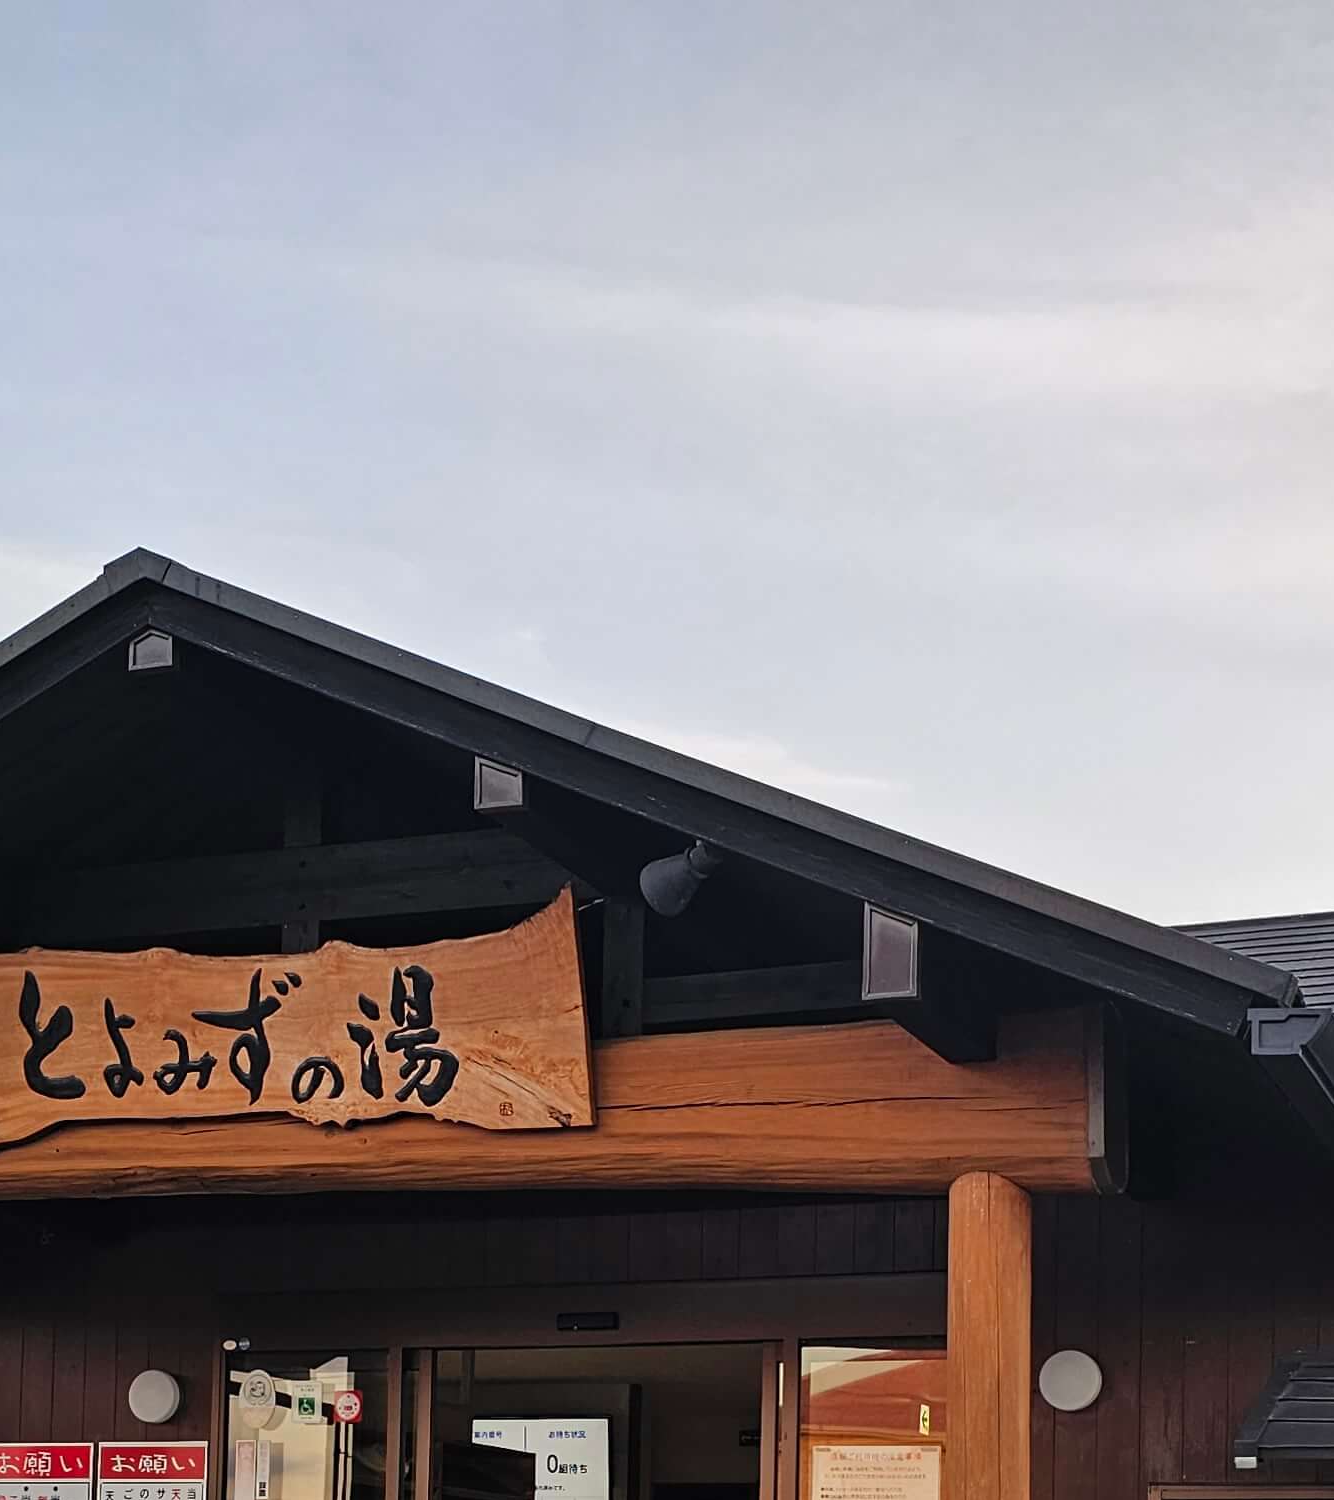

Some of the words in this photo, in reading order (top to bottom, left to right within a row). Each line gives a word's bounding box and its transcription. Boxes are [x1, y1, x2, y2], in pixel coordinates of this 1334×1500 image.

[19, 965, 459, 1106] とよみずの湯
[110, 1453, 196, 1475] お願い
